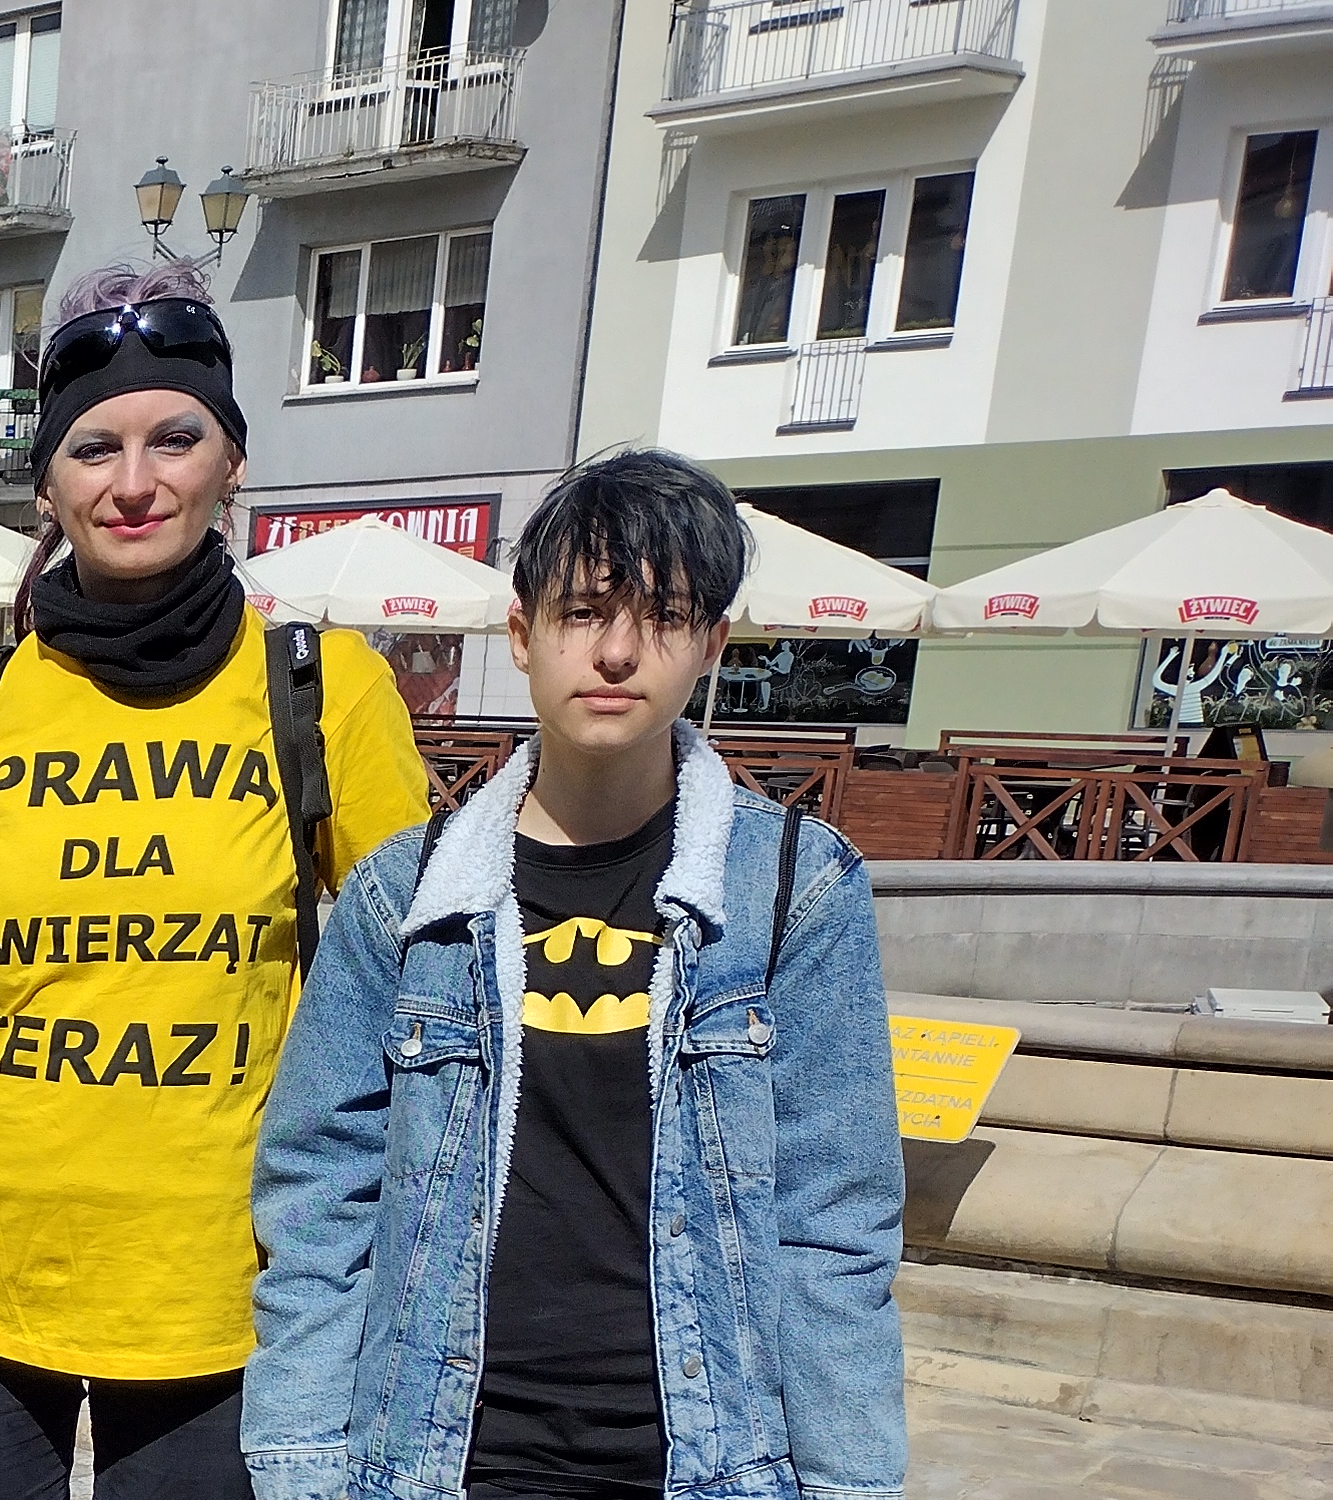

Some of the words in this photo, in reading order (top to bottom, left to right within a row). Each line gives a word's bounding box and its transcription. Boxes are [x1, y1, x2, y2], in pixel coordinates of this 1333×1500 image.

[389, 597, 433, 612] ŻYWIEC
[817, 598, 862, 615] ŻYWIEC
[991, 595, 1036, 613] ŻYWIEC
[1189, 597, 1253, 619] ŻYWIEC
[60, 834, 175, 880] DLA
[891, 1026, 916, 1039] AZ
[895, 1089, 973, 1111] EZDATNA
[900, 1111, 941, 1129] YCIA
